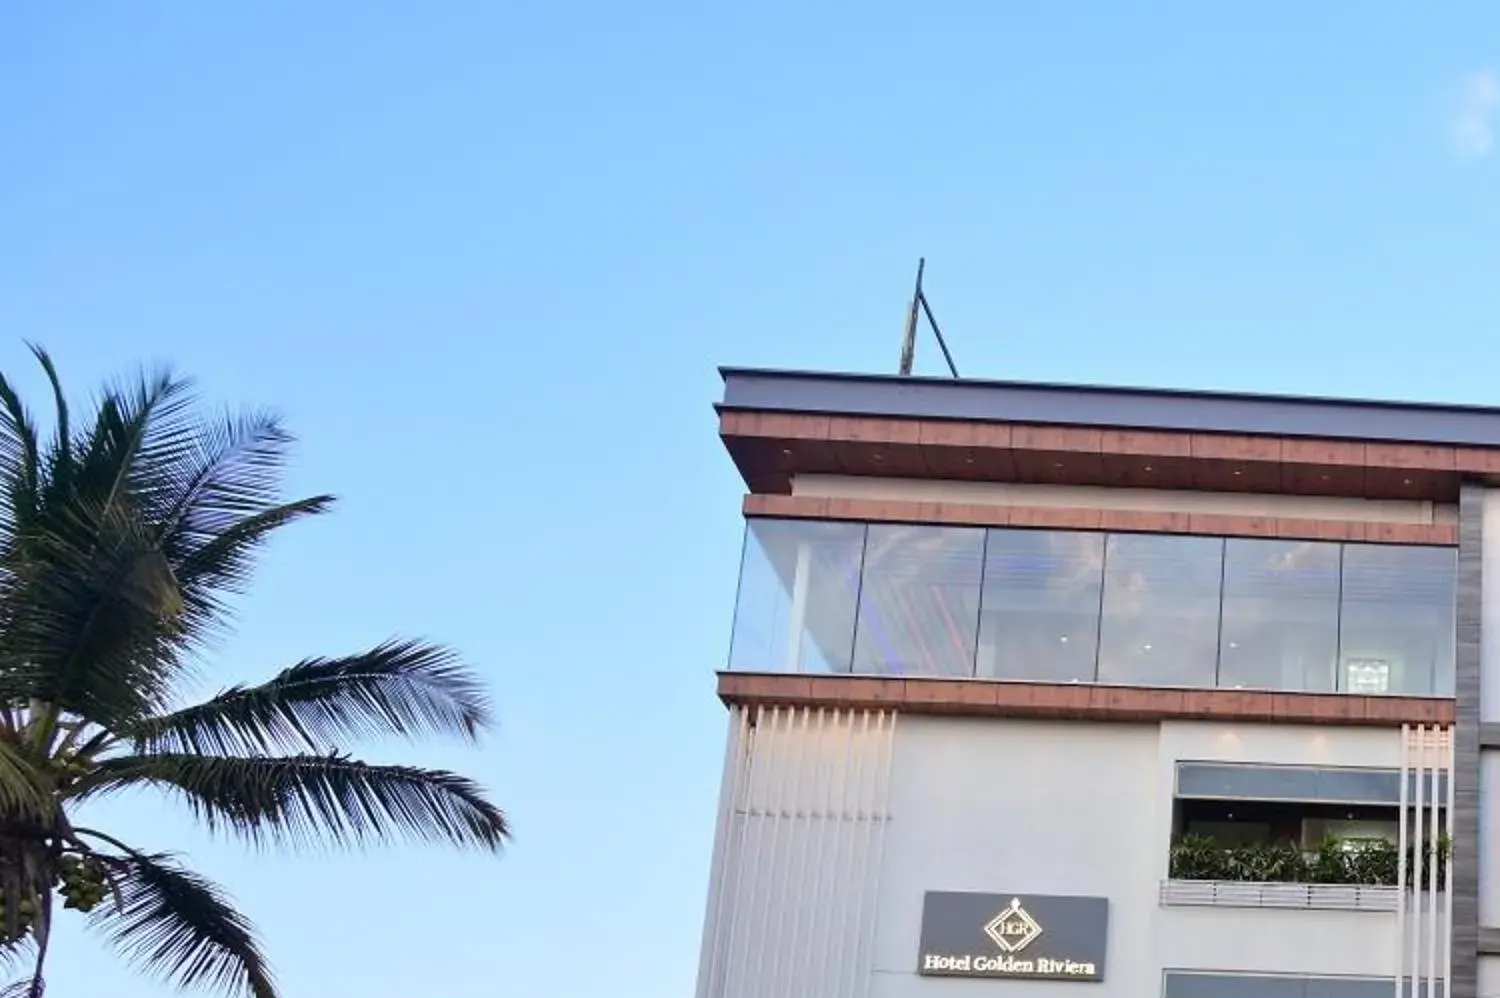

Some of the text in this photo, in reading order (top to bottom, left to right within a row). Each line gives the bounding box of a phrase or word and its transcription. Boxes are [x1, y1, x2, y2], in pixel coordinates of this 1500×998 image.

[923, 955, 1096, 975] Hotel Golden Riviera
